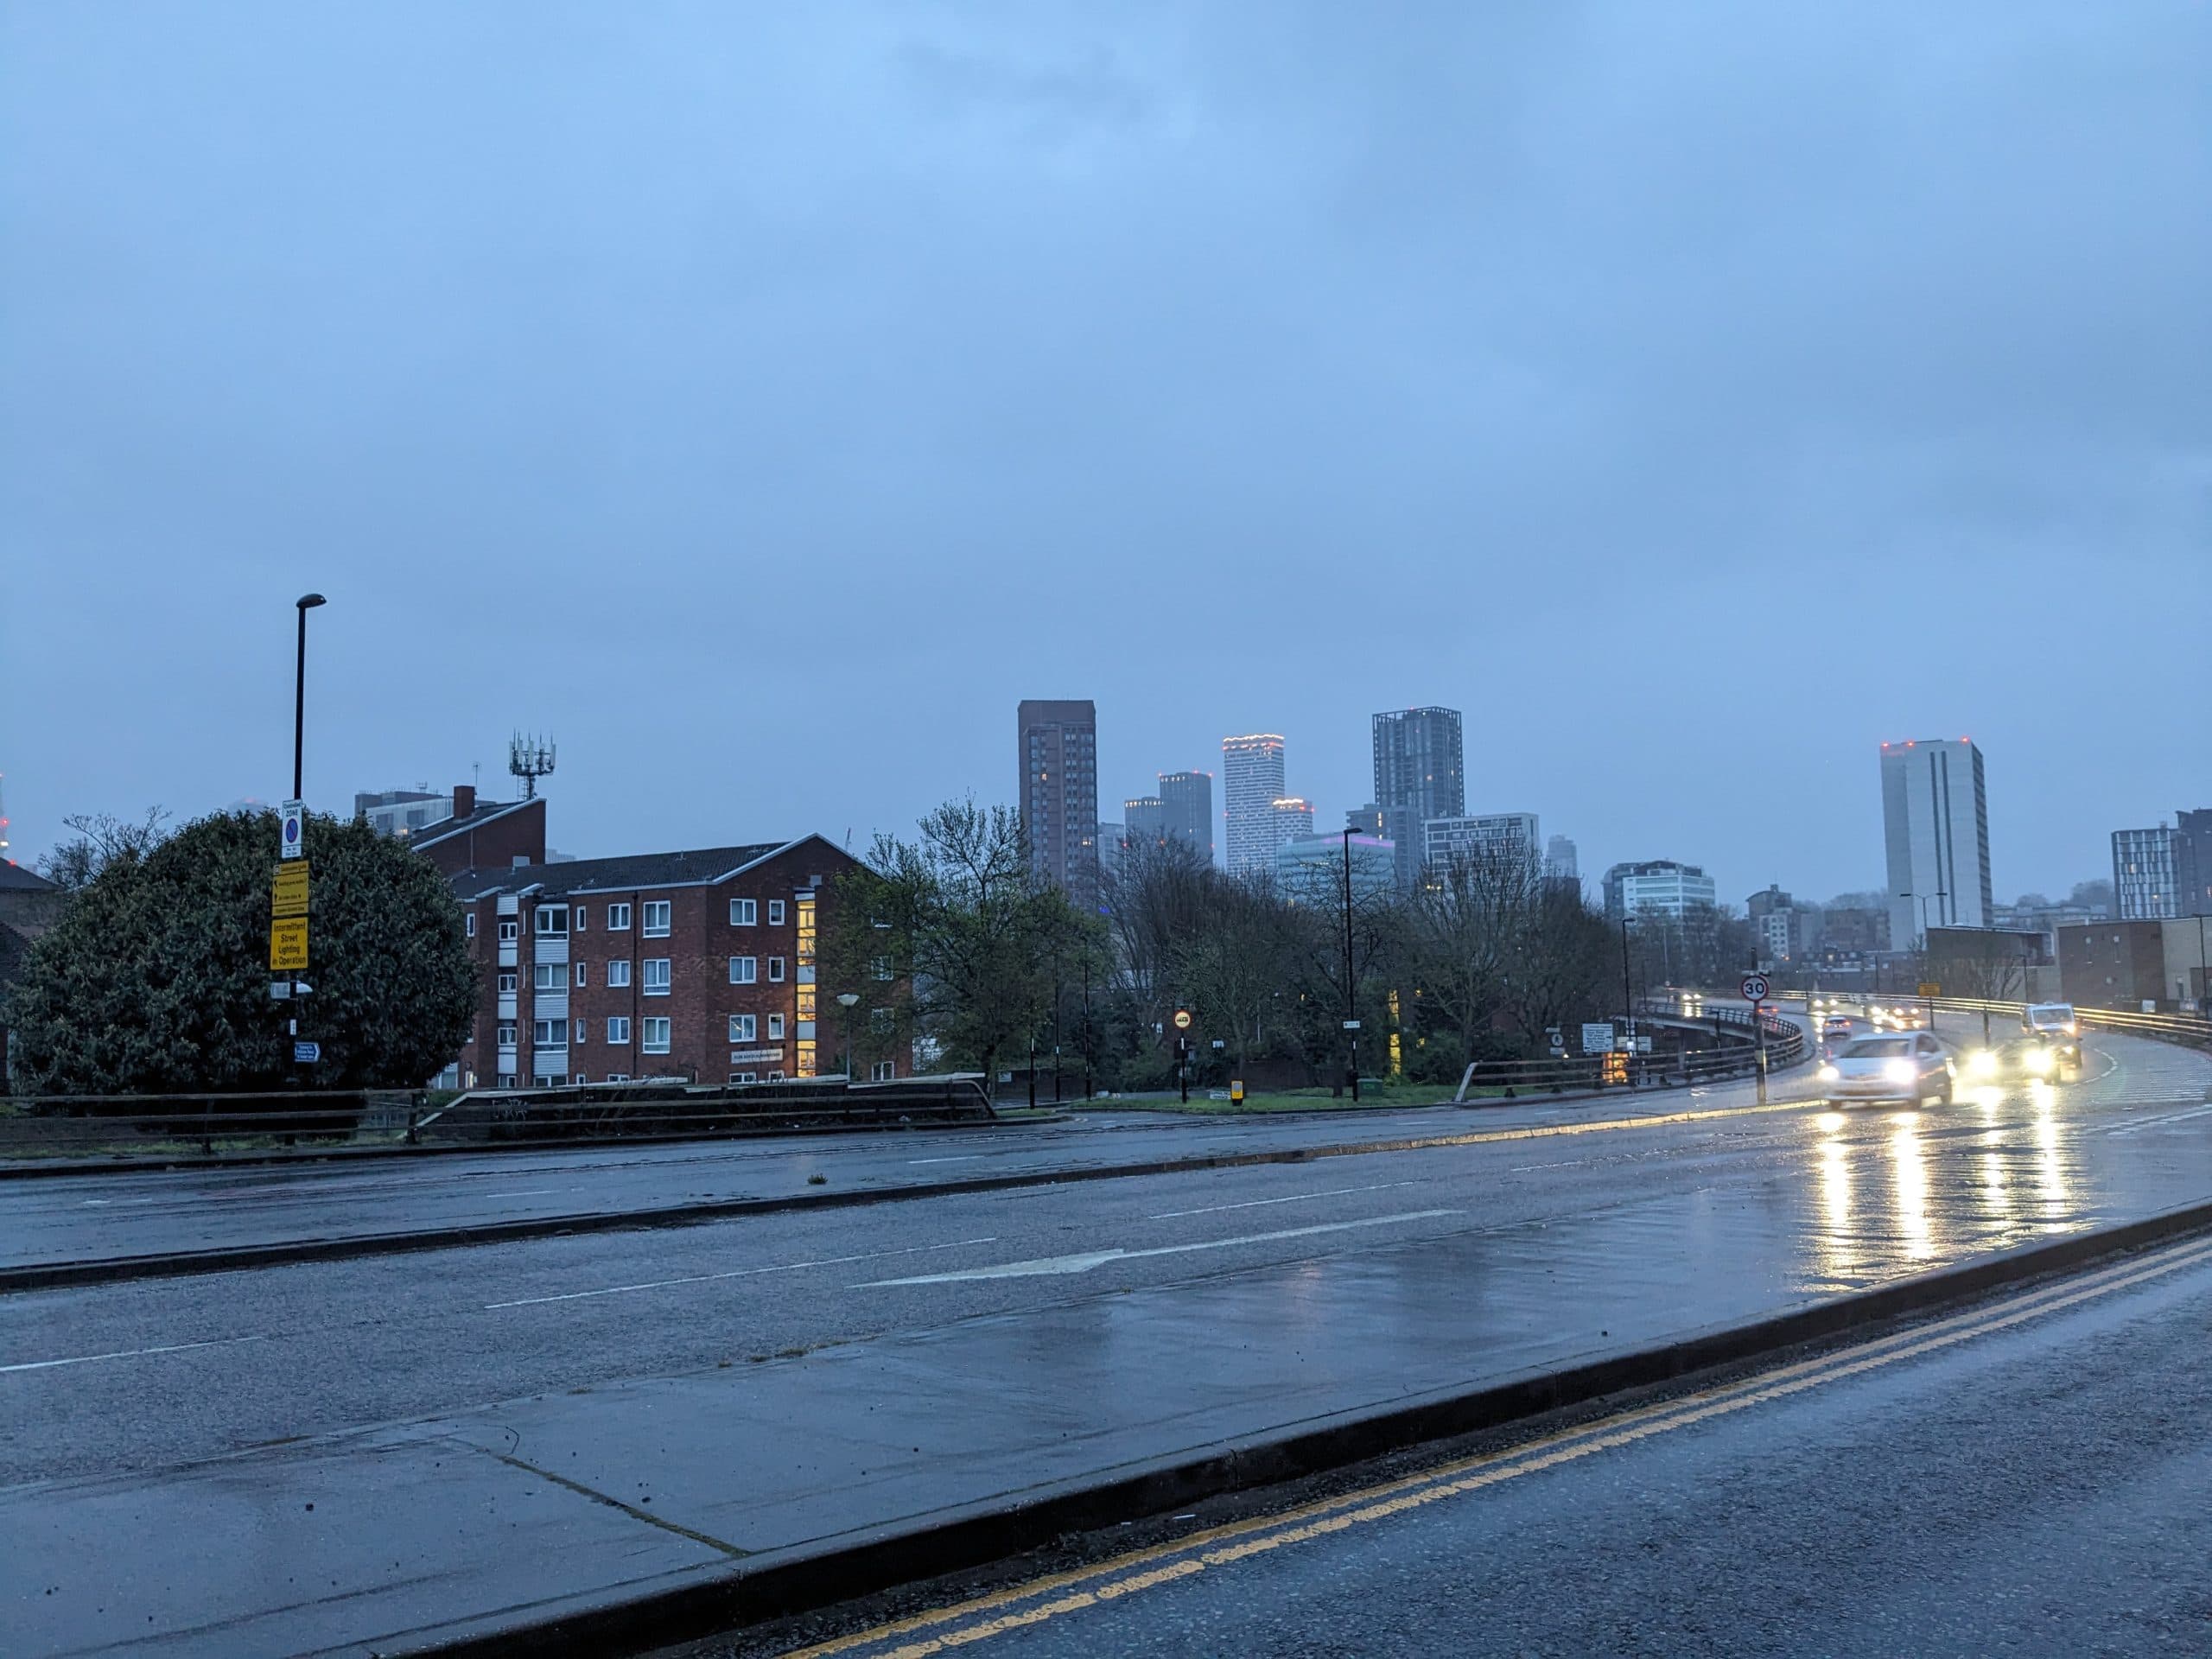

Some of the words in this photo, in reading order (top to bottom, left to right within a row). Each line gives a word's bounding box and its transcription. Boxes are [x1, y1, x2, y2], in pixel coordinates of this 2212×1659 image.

[273, 922, 306, 931] Intermittent
[281, 934, 298, 943] Street
[278, 946, 300, 956] Lighting
[278, 956, 306, 966] Operation
[1745, 982, 1764, 994] 30
